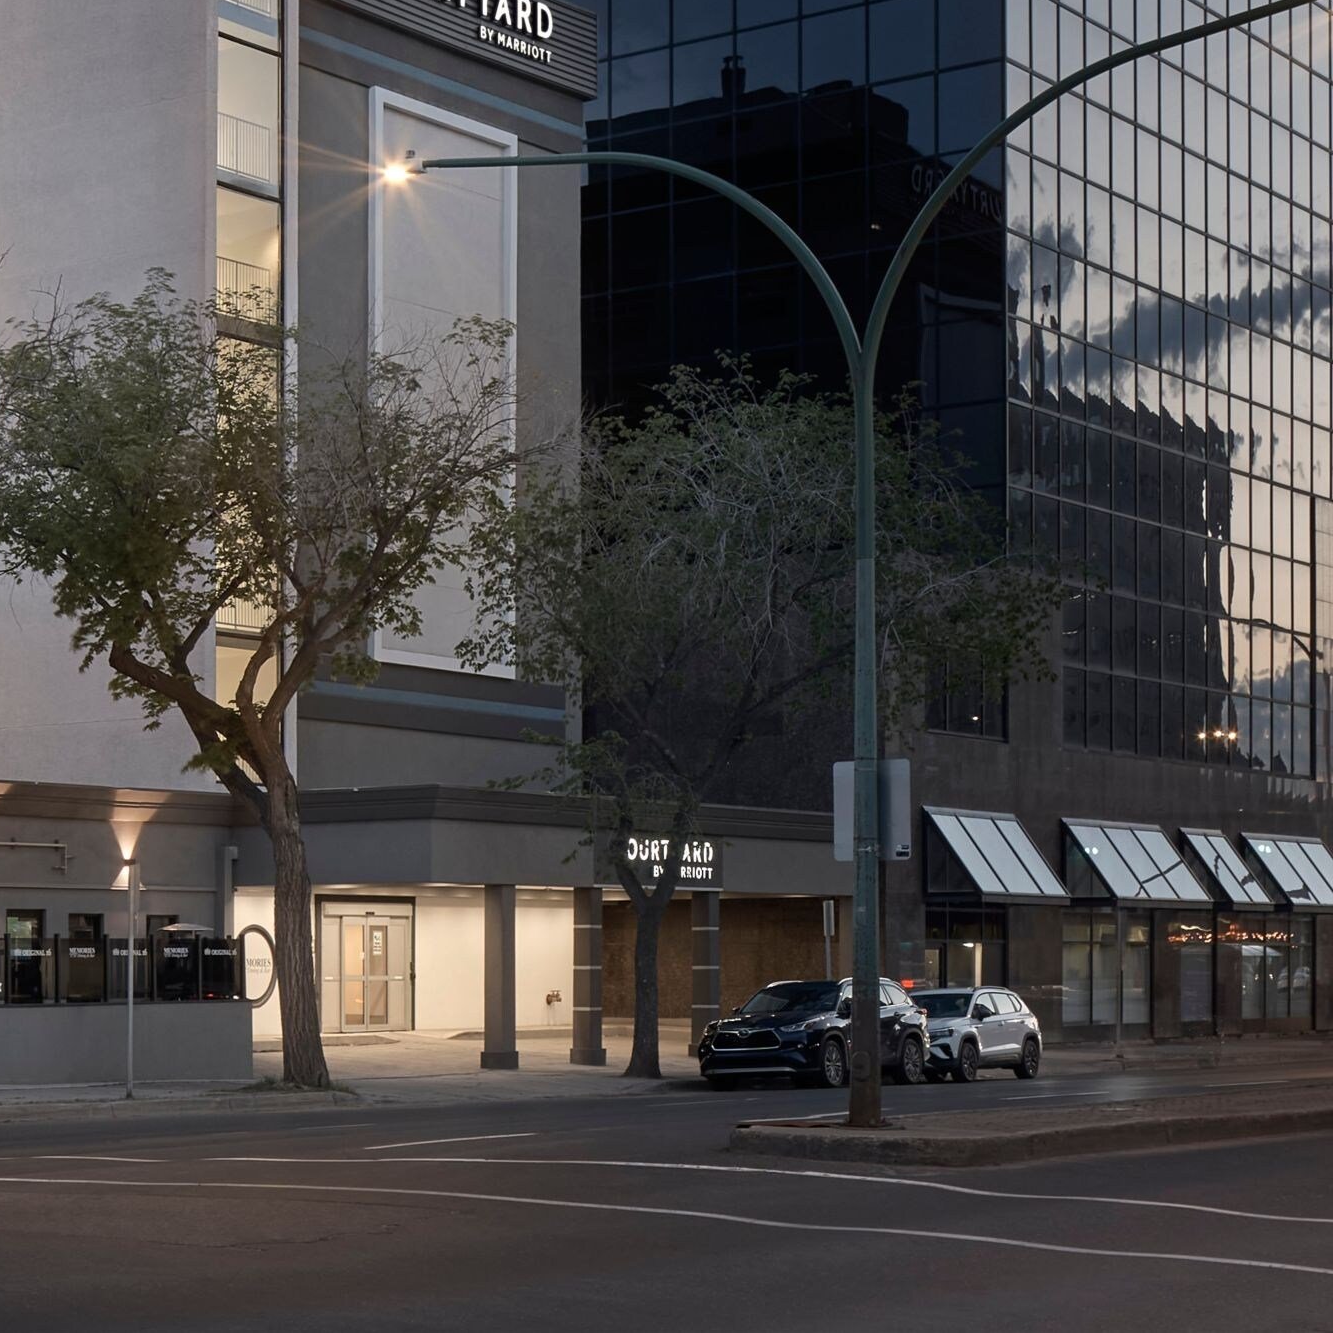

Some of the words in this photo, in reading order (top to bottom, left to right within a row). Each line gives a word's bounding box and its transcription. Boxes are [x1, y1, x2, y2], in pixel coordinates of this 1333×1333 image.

[480, 25, 494, 42] BY
[497, 32, 552, 63] MARRIOTT
[627, 837, 713, 863] OURTARD
[680, 866, 713, 880] RRIOTT
[246, 958, 271, 968] MORIES
